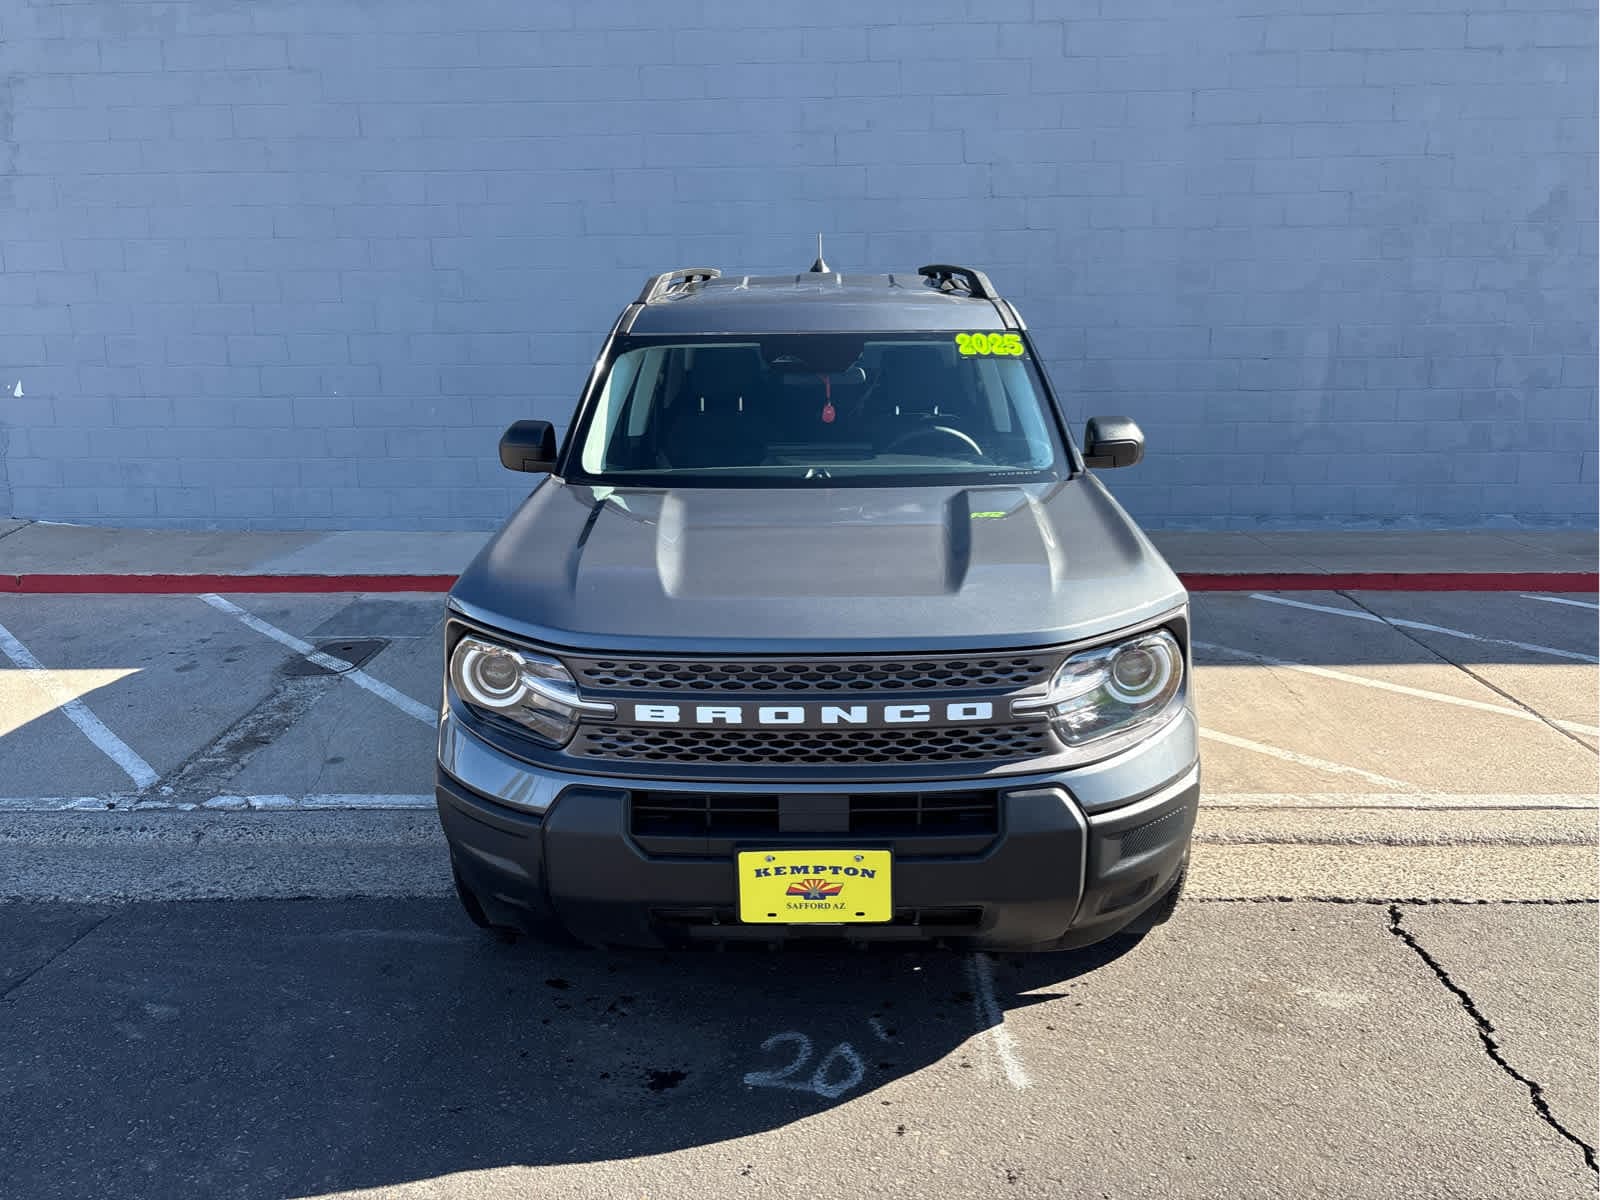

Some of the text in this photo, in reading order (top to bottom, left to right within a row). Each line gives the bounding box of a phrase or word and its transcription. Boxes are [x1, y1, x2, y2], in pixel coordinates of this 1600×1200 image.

[955, 333, 1024, 356] 2025
[634, 702, 993, 724] BRONCO
[754, 865, 877, 879] KEMPTON
[786, 902, 847, 910] SAFFORD AZ
